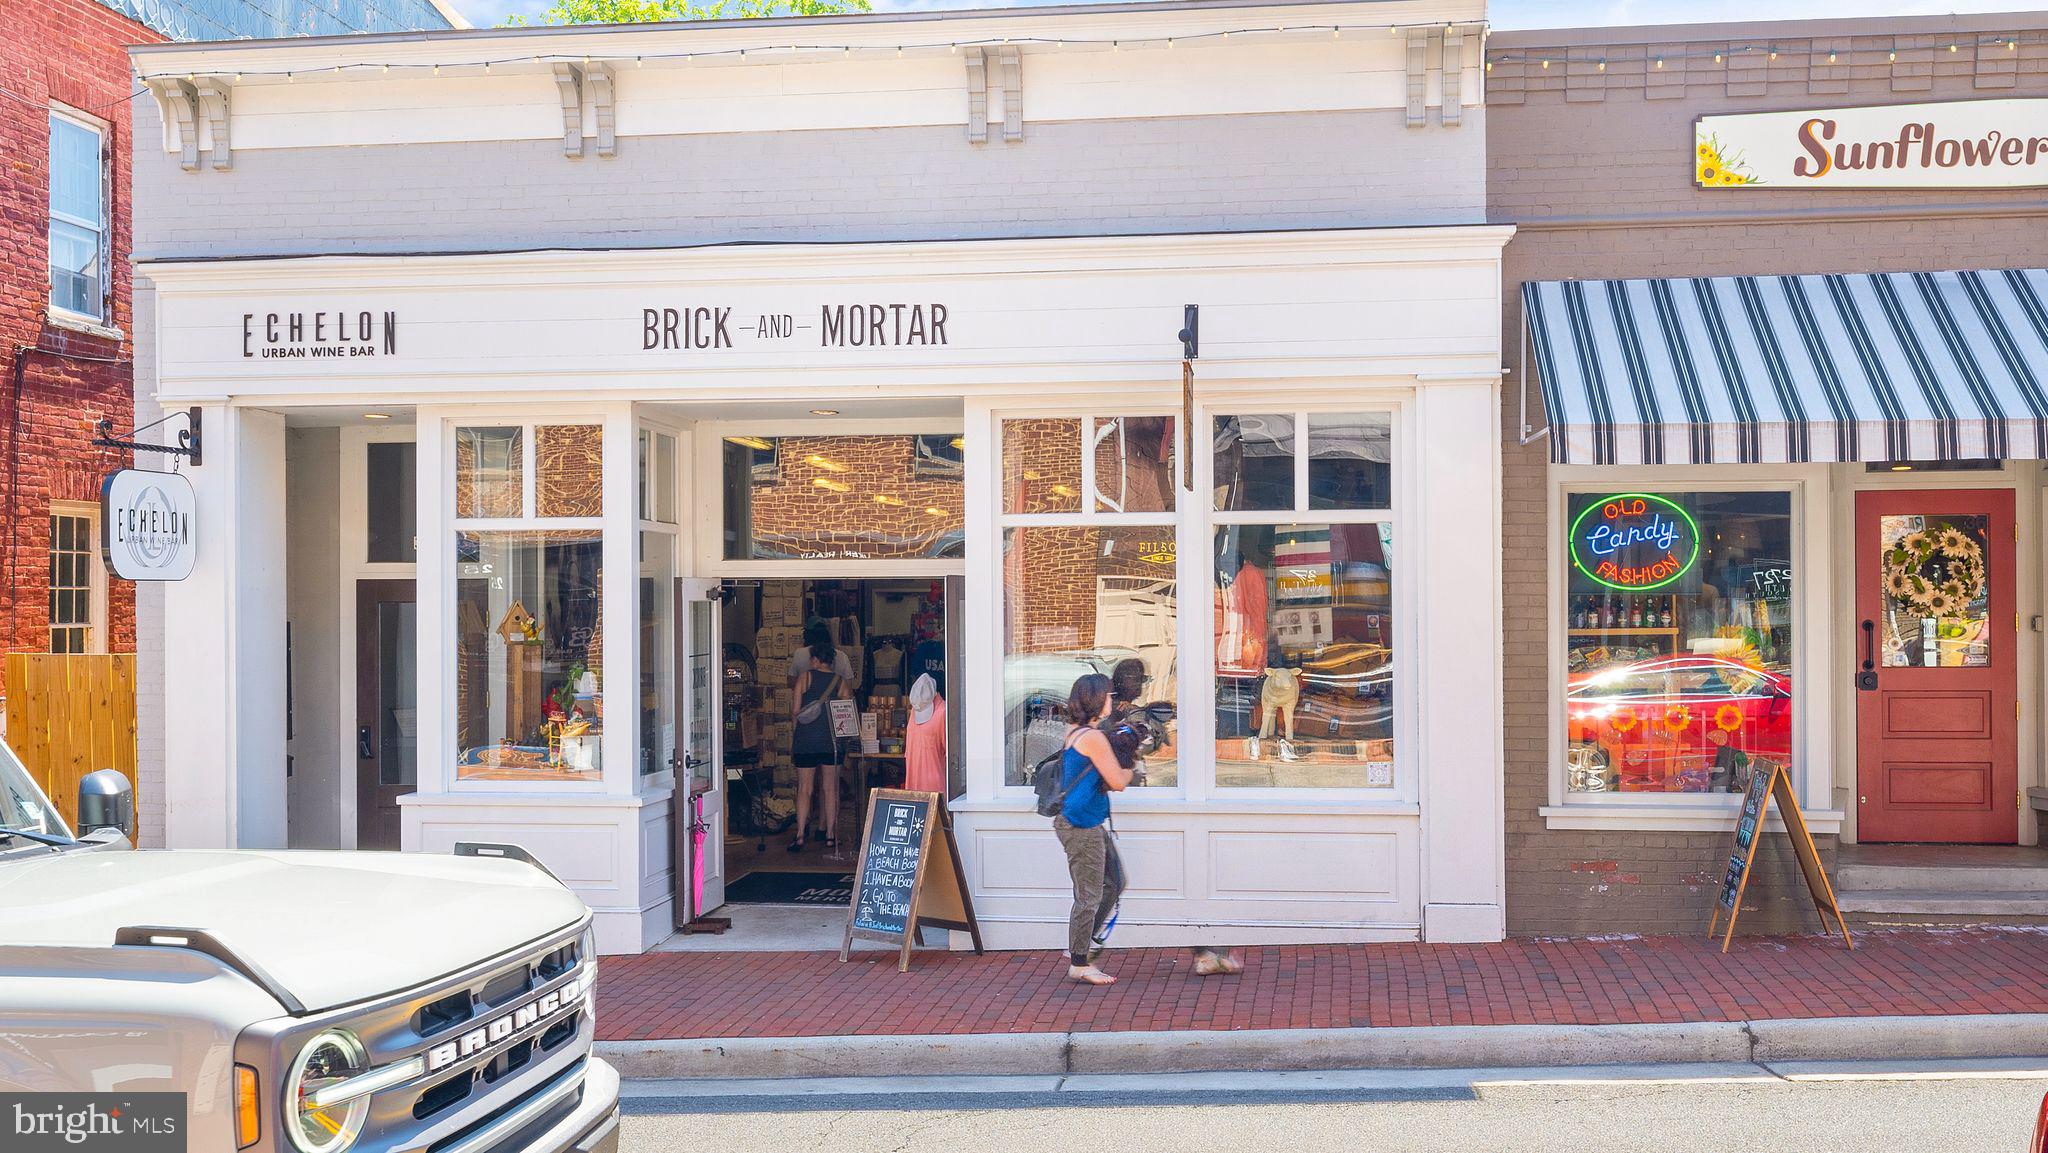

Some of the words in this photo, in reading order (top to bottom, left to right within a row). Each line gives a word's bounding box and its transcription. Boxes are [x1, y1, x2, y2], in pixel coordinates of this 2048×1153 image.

[243, 311, 396, 358] ECHELON
[642, 306, 734, 350] BRICK
[757, 314, 793, 339] AND
[821, 303, 949, 347] MORTAR
[262, 347, 305, 358] URBAN
[310, 347, 345, 357] WINE
[350, 346, 375, 357] BAR
[1603, 499, 1647, 519] OLD
[118, 508, 188, 545] ECHELON
[1586, 513, 1680, 554] Candy
[1596, 553, 1680, 584] FASHION
[867, 858, 873, 869] A
[876, 856, 899, 870] BEACH
[869, 843, 886, 858] HOW
[891, 846, 901, 856] TO
[861, 889, 873, 905] 2.
[886, 891, 896, 903] TO
[879, 901, 892, 916] THE
[429, 981, 580, 1071] BRONCO
